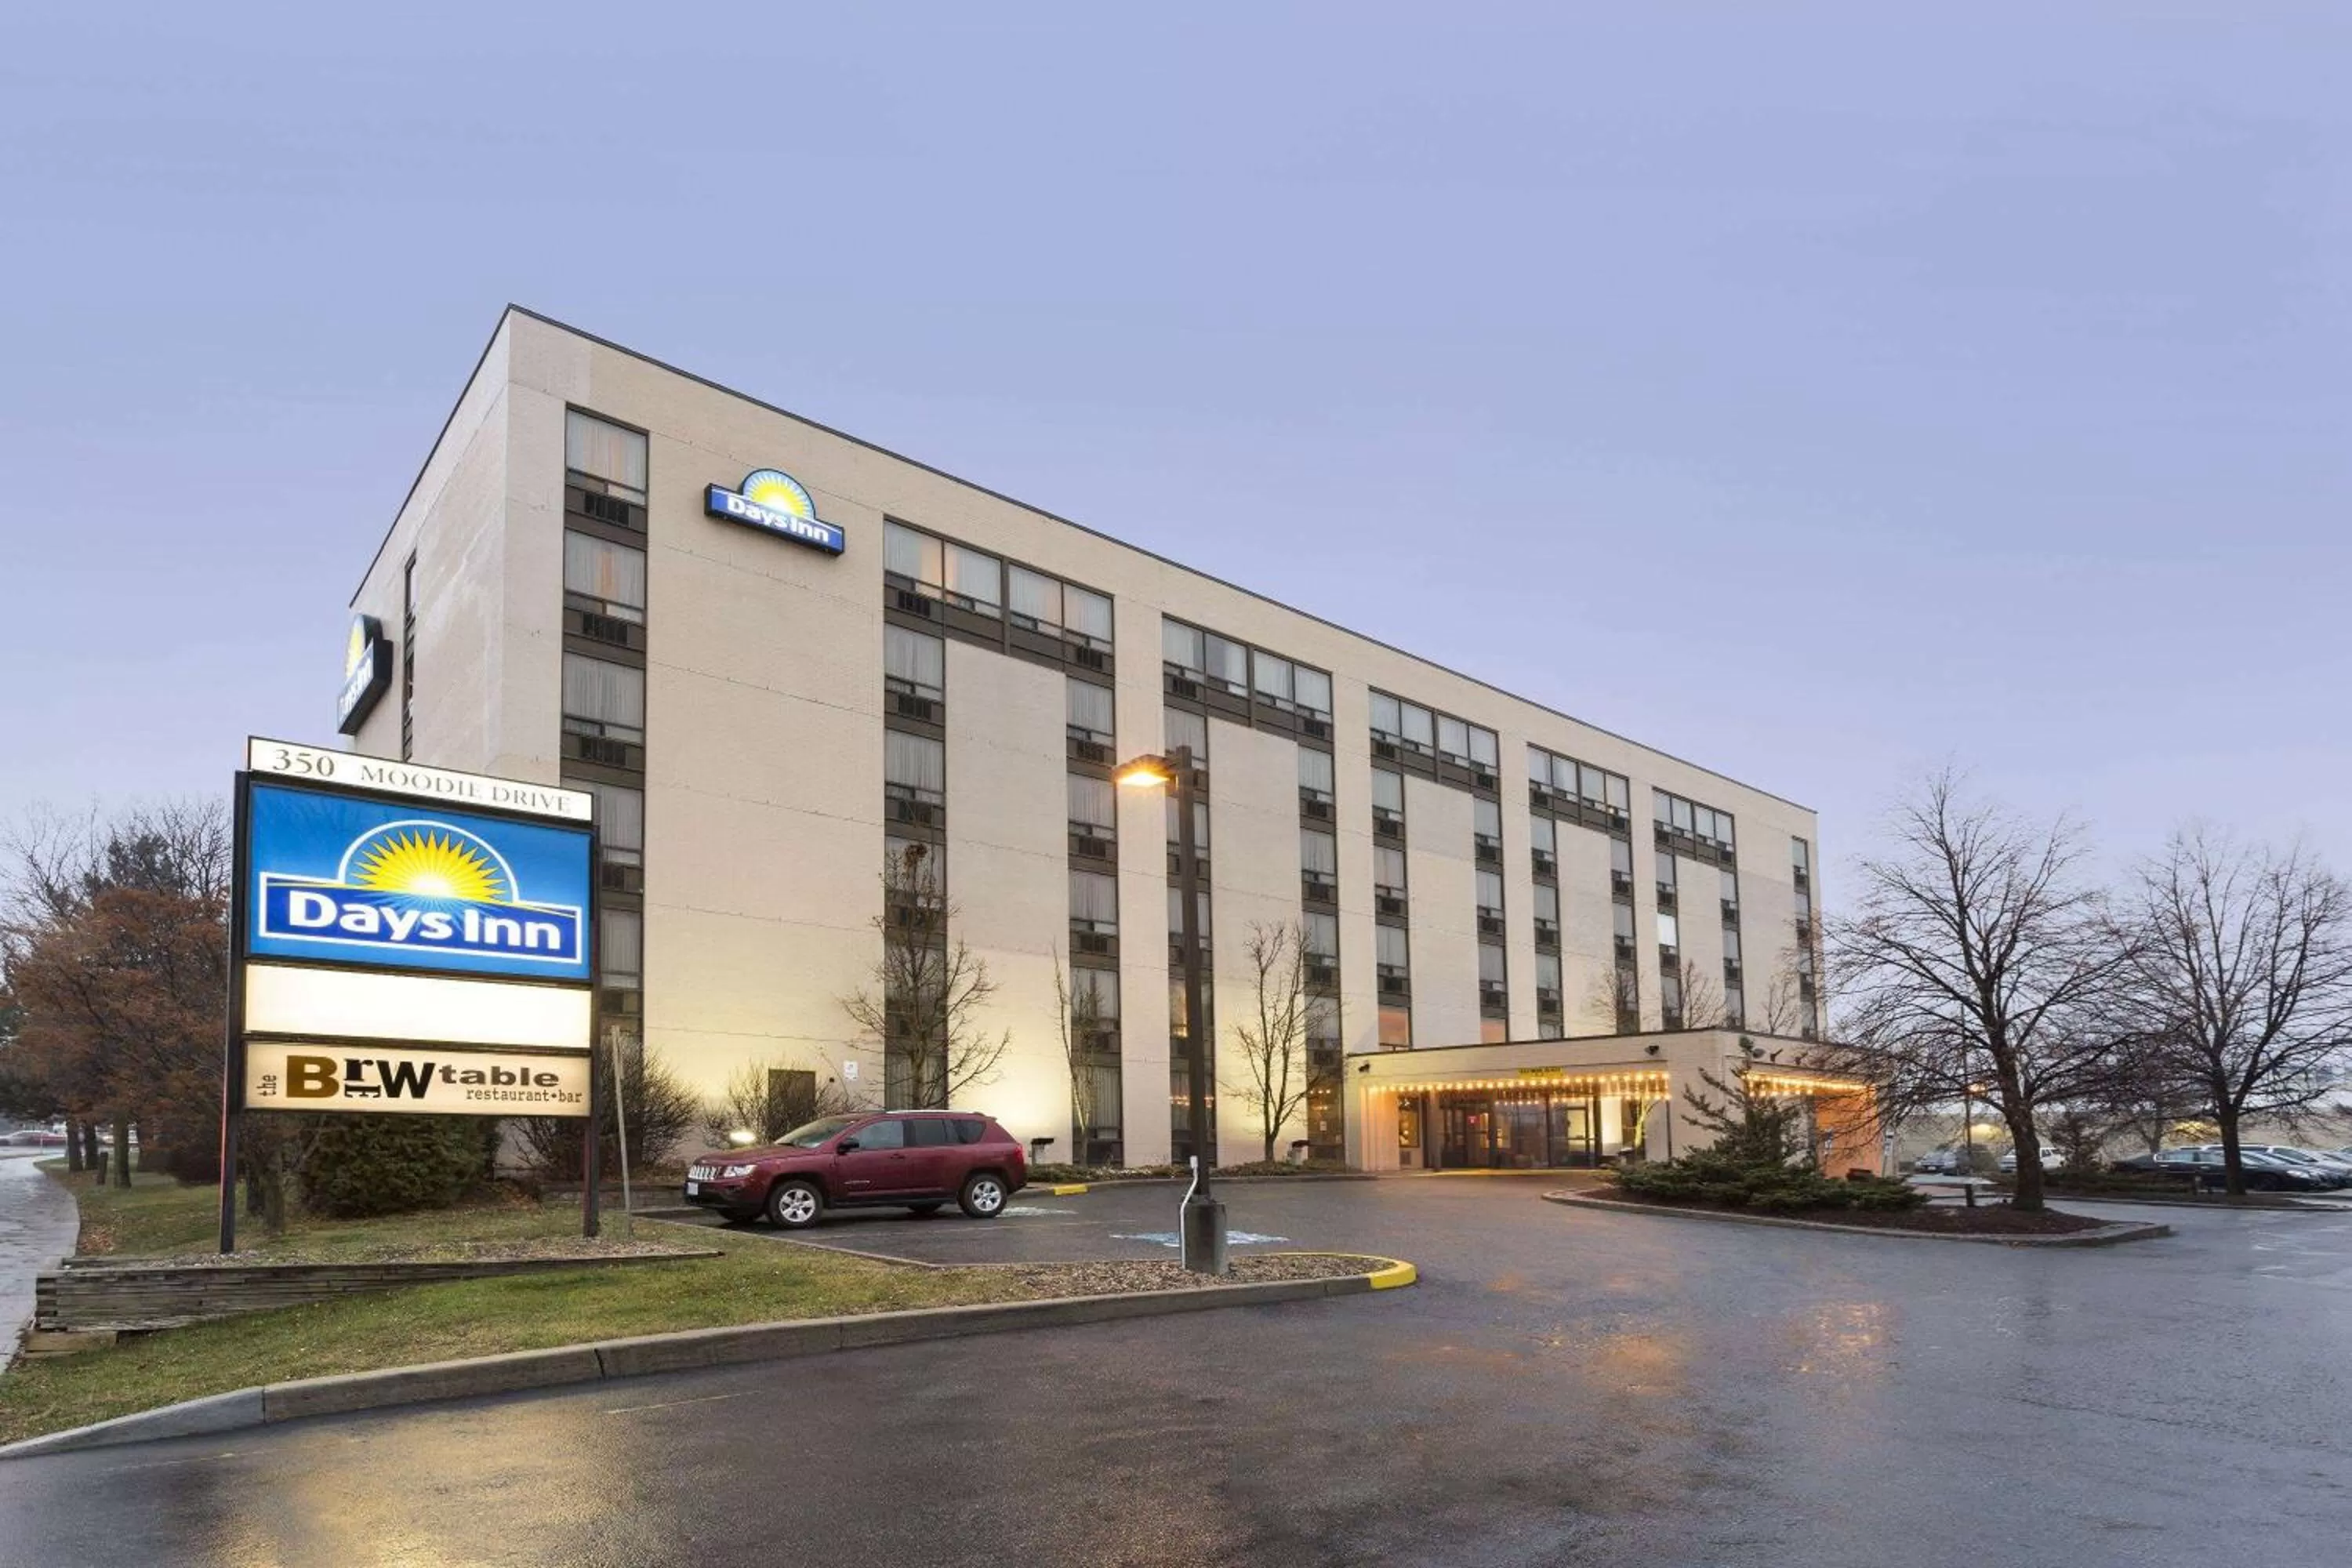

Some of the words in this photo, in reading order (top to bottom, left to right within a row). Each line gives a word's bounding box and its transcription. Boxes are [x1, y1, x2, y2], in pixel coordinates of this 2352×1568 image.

[726, 494, 788, 528] Days
[790, 517, 829, 543] Inn
[272, 749, 335, 777] 350
[361, 764, 483, 800] MOODIE
[492, 786, 572, 815] DRIVE
[289, 890, 453, 942] Days
[464, 909, 561, 950] Inn
[256, 1074, 277, 1097] the
[438, 1064, 560, 1087] table
